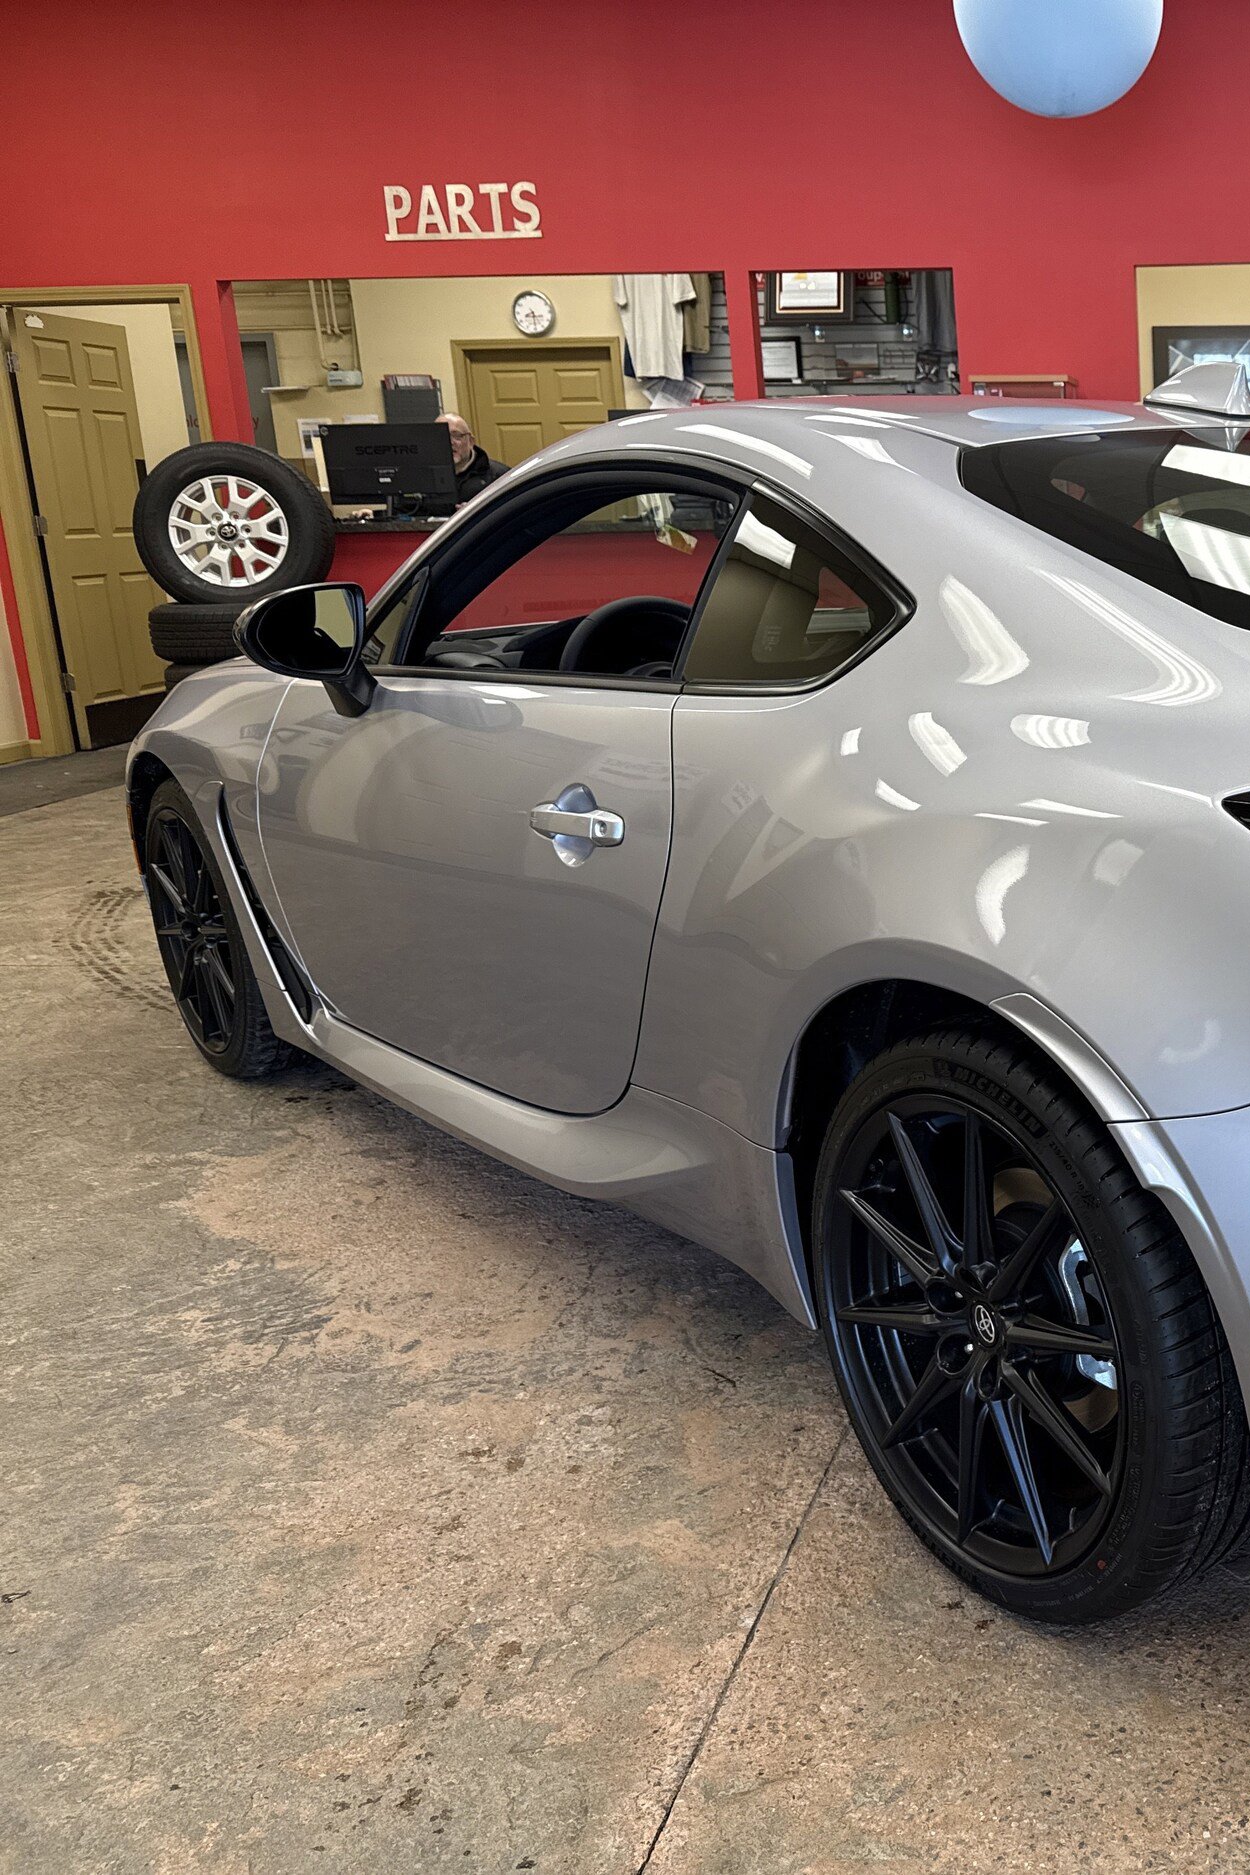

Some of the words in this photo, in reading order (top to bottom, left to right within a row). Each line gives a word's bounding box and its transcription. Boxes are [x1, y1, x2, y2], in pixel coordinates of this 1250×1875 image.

[383, 181, 542, 237] PARTS
[355, 444, 419, 455] SCEPTRE
[952, 1066, 1043, 1135] MICHELIN
